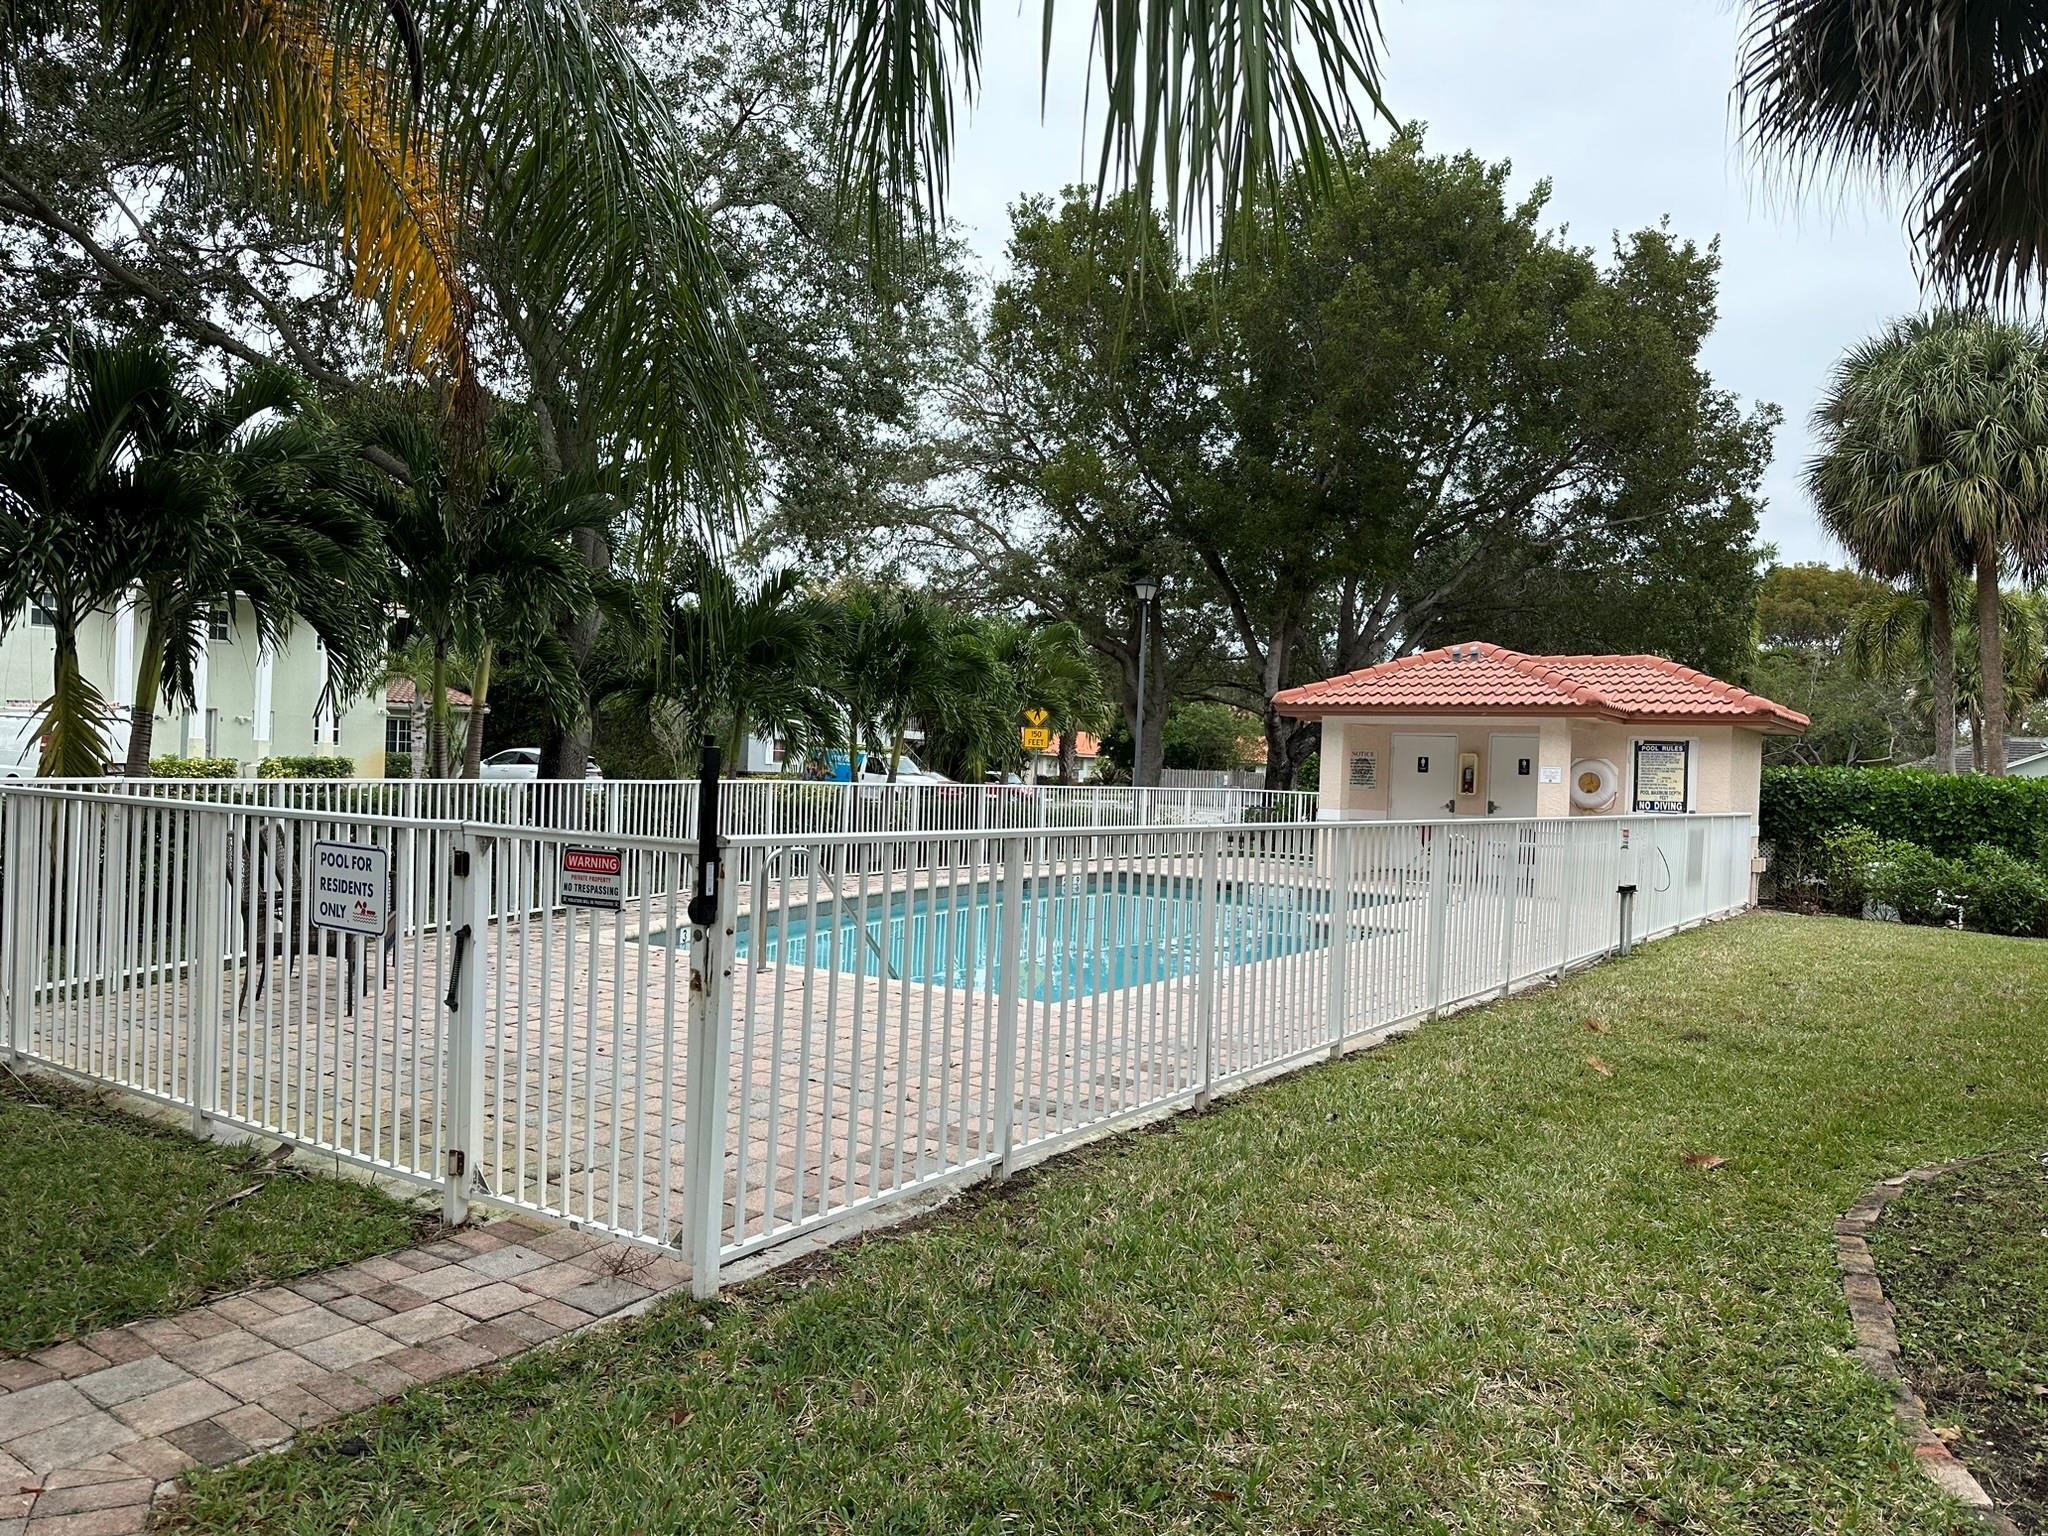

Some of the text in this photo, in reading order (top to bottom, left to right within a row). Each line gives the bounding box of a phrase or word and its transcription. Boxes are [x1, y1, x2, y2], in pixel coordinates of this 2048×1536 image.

[1031, 730, 1042, 738] 150
[1028, 738, 1044, 746] FEET
[1639, 801, 1683, 811] NO DIVING
[320, 851, 373, 872] POOL FOR
[568, 855, 617, 870] WARNING
[571, 874, 611, 884] PRIVATE PROPERTY
[320, 876, 374, 898] RESIDENTS
[563, 882, 619, 896] NO TRESPASSING
[320, 901, 347, 919] ONLY
